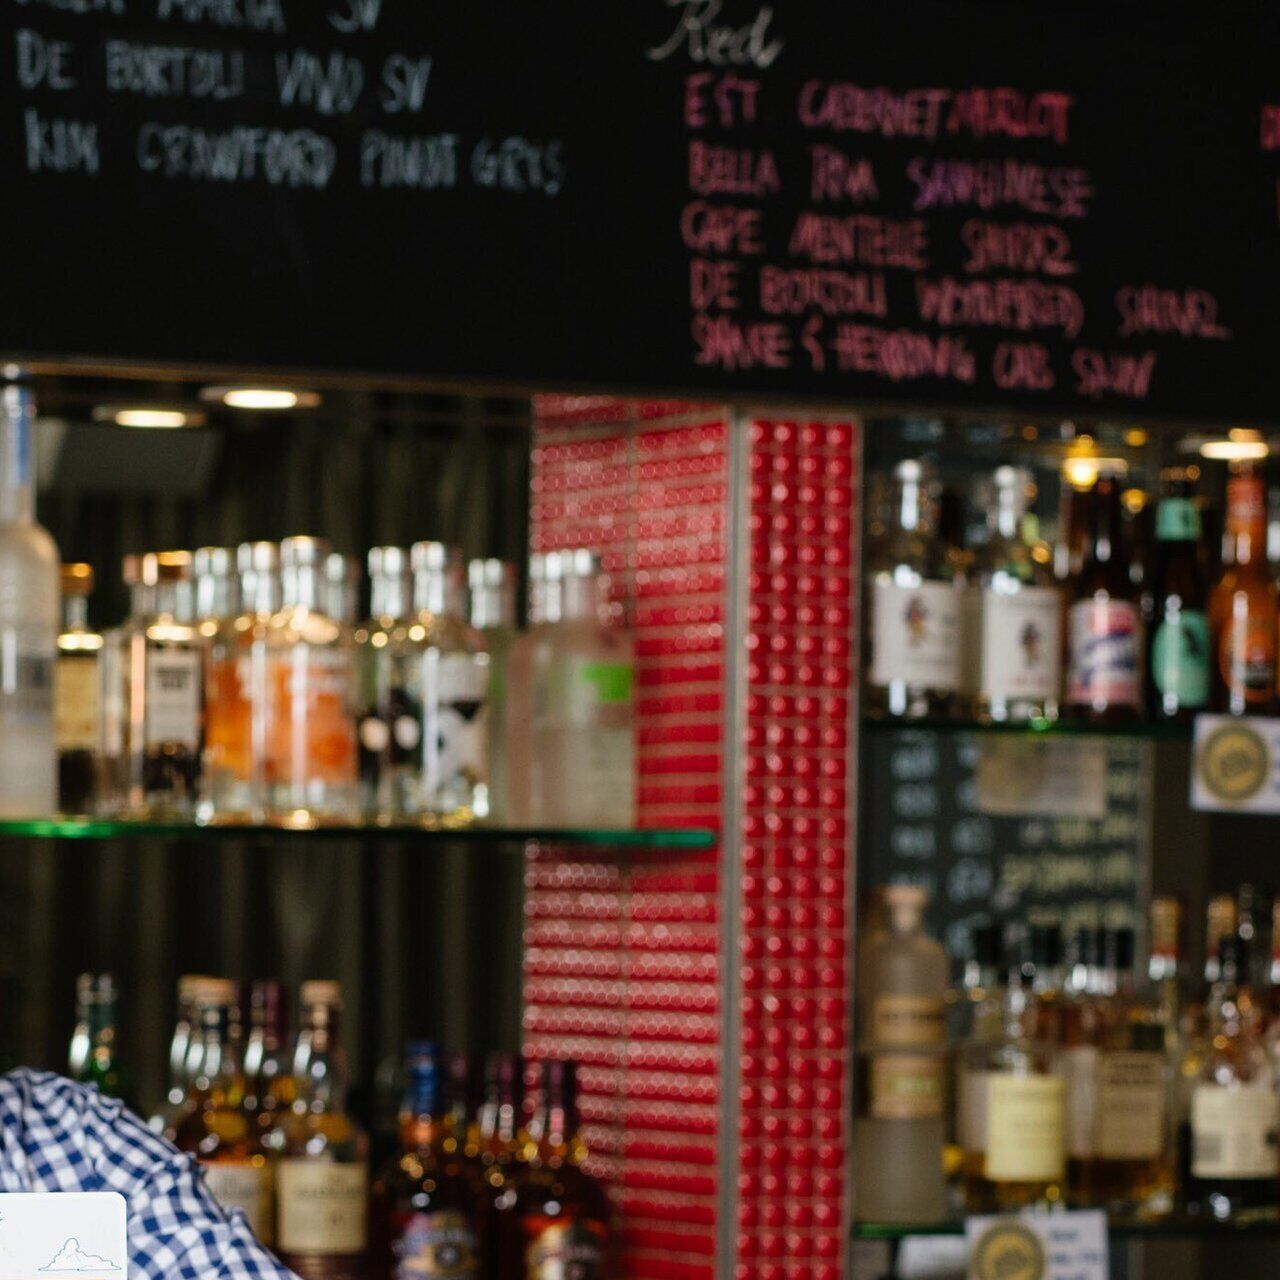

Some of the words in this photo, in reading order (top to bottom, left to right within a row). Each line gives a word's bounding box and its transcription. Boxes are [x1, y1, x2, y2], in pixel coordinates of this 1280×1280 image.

[15, 29, 76, 90] DE
[646, 0, 784, 68] Red
[689, 258, 743, 313] DE
